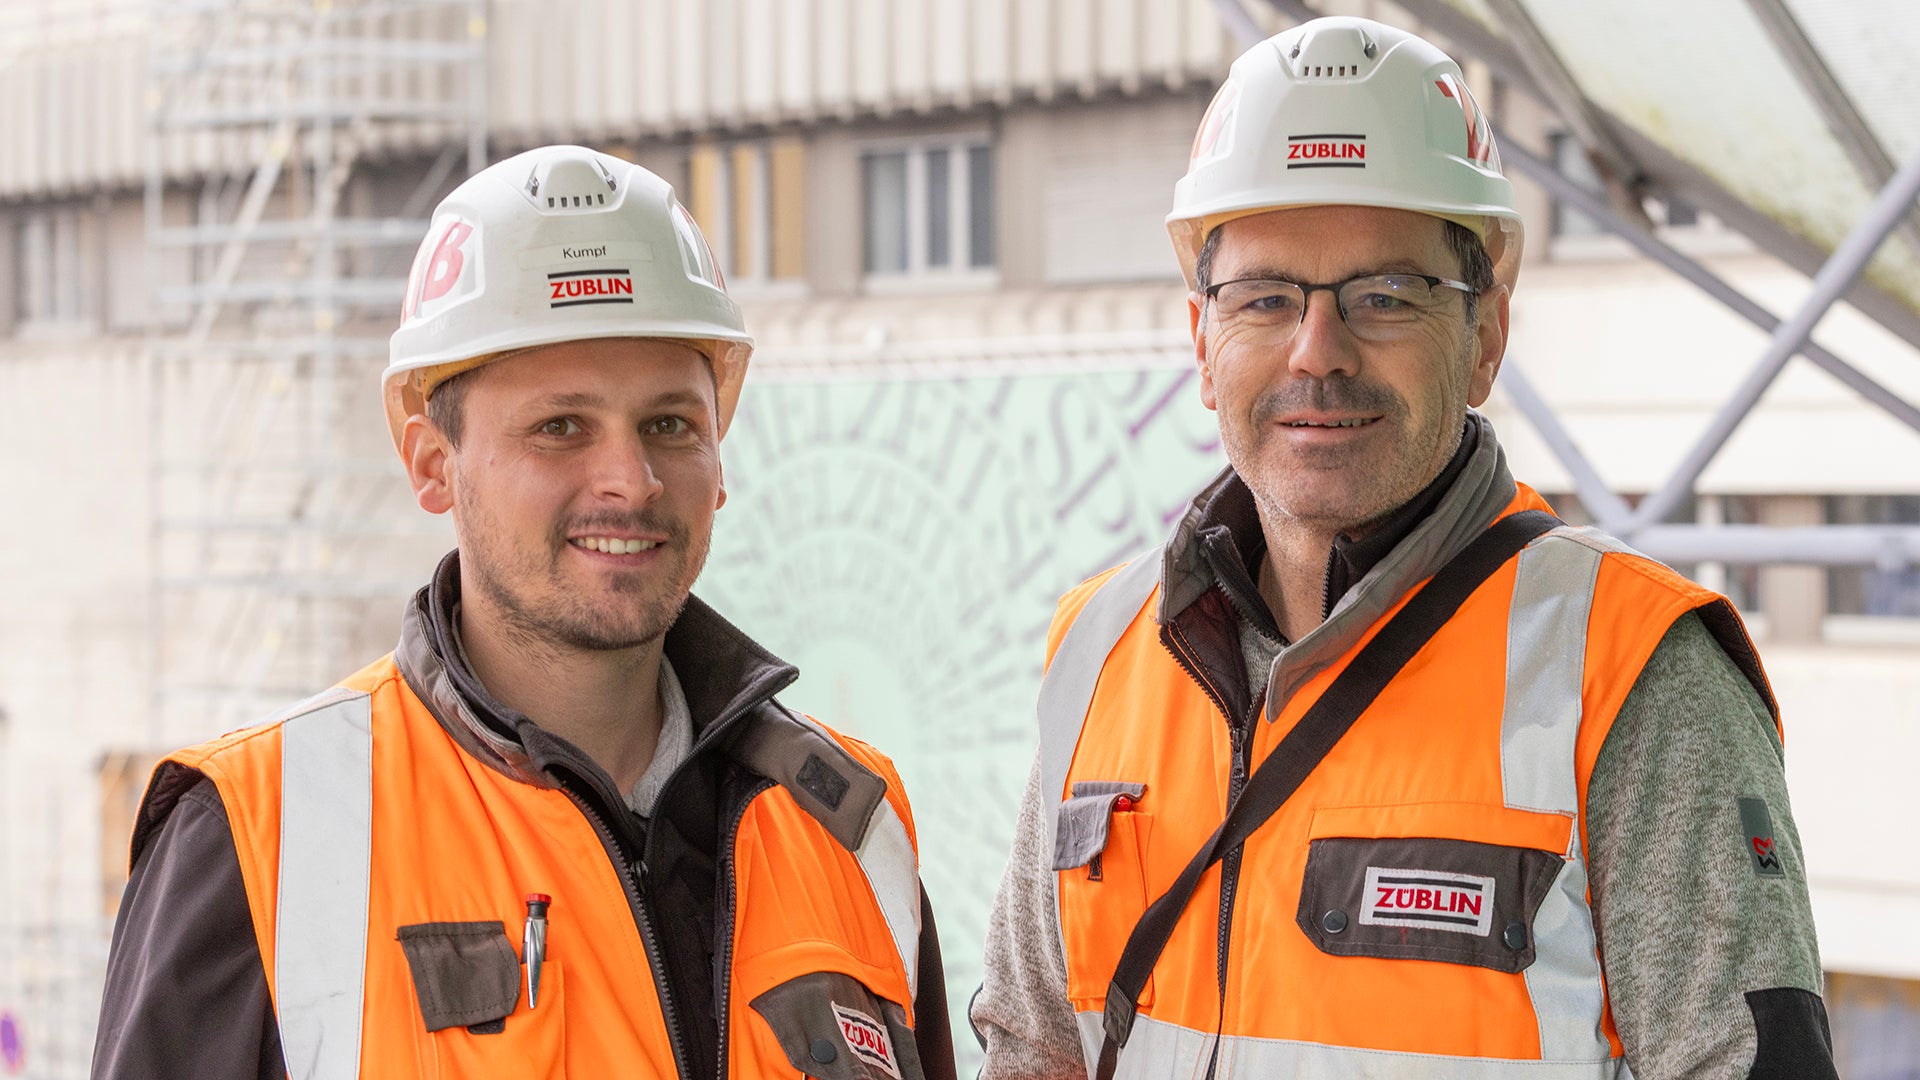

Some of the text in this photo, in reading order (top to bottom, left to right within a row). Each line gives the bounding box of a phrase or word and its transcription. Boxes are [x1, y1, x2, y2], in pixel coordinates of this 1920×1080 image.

[1287, 142, 1366, 160] ZÜBLIN
[562, 245, 606, 258] Kumpf
[550, 277, 633, 299] ZÜBLIN
[1375, 887, 1482, 916] ZÜBLIN
